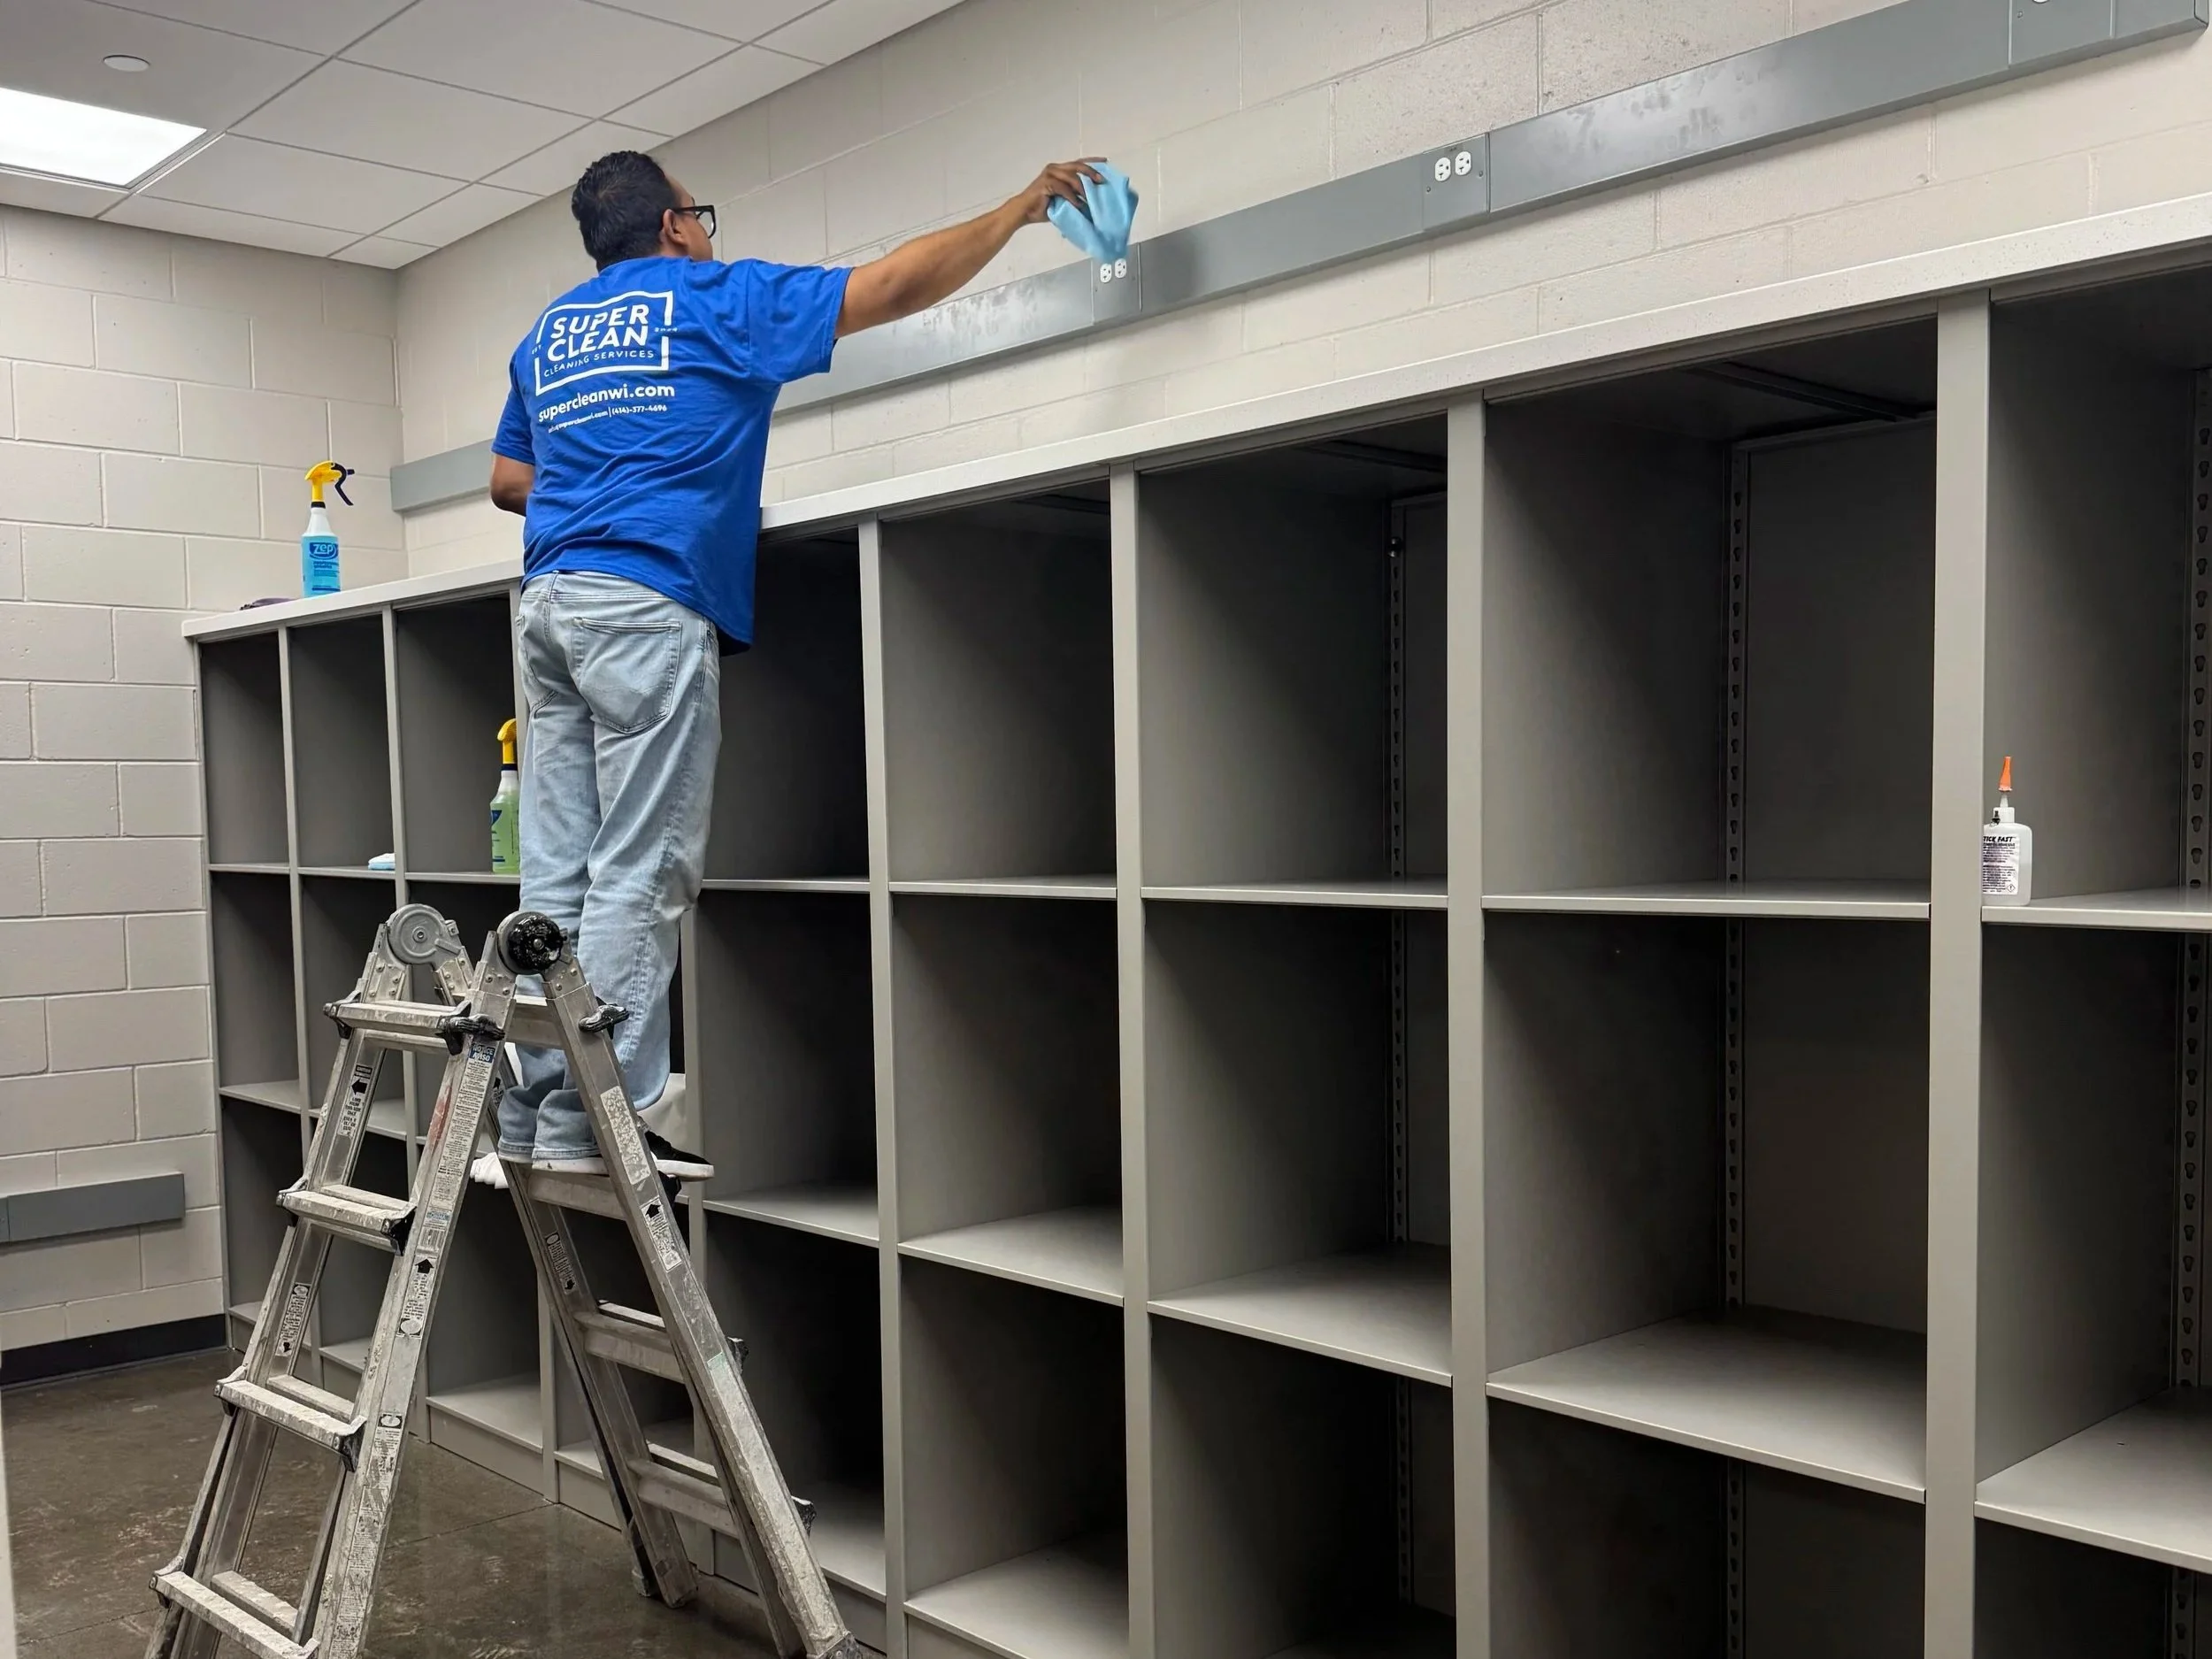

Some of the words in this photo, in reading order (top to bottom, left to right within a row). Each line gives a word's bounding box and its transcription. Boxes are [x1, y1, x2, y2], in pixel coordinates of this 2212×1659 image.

[550, 303, 649, 339] SUPER
[547, 325, 649, 362] CLEAN
[594, 349, 654, 361] SERVICES
[543, 355, 590, 378] CLEANING
[538, 383, 675, 422] supercleanwi.com
